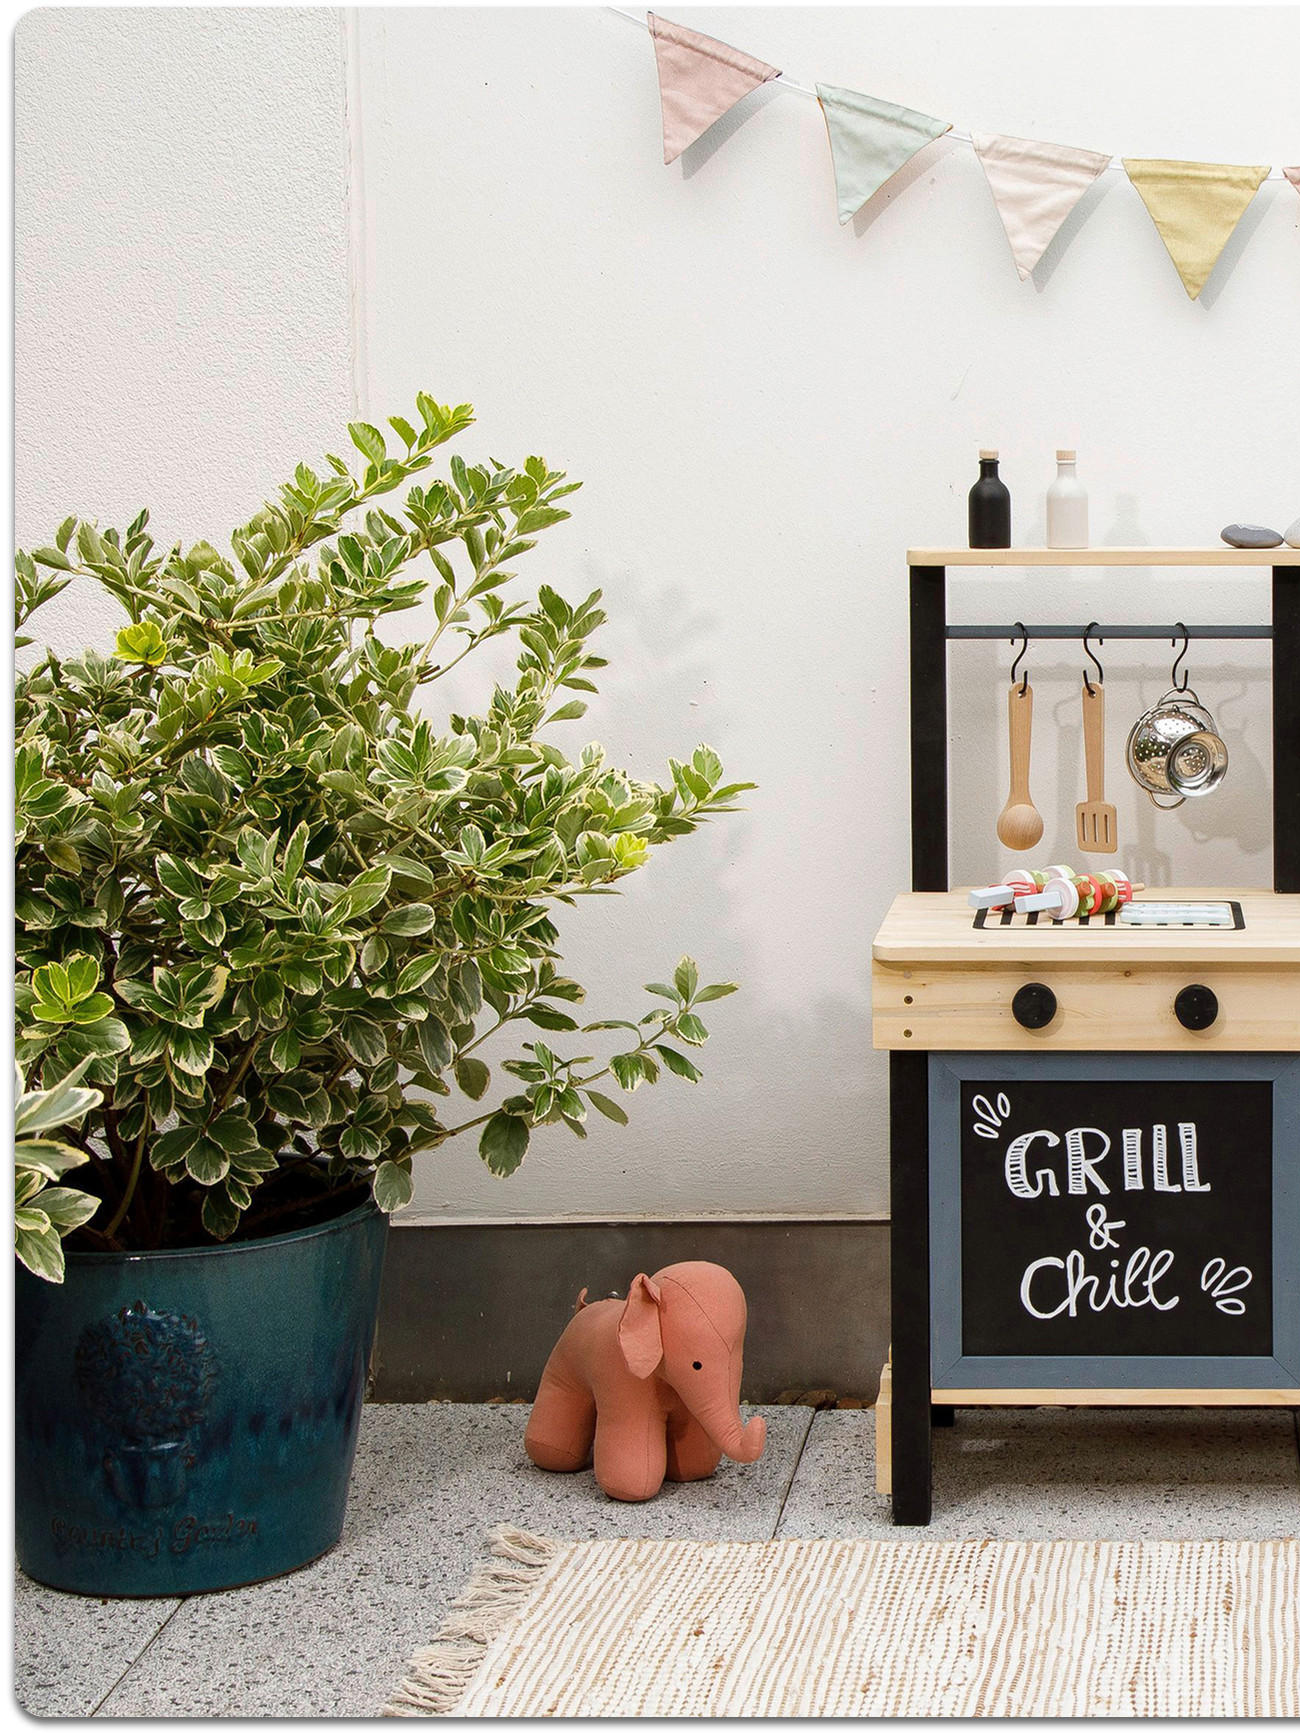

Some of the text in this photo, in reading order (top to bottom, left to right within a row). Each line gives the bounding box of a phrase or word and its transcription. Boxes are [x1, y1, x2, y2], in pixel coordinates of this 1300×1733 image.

[1004, 1122, 1211, 1199] GRILL
[1085, 1203, 1126, 1250] &
[1020, 1246, 1180, 1320] Chill
